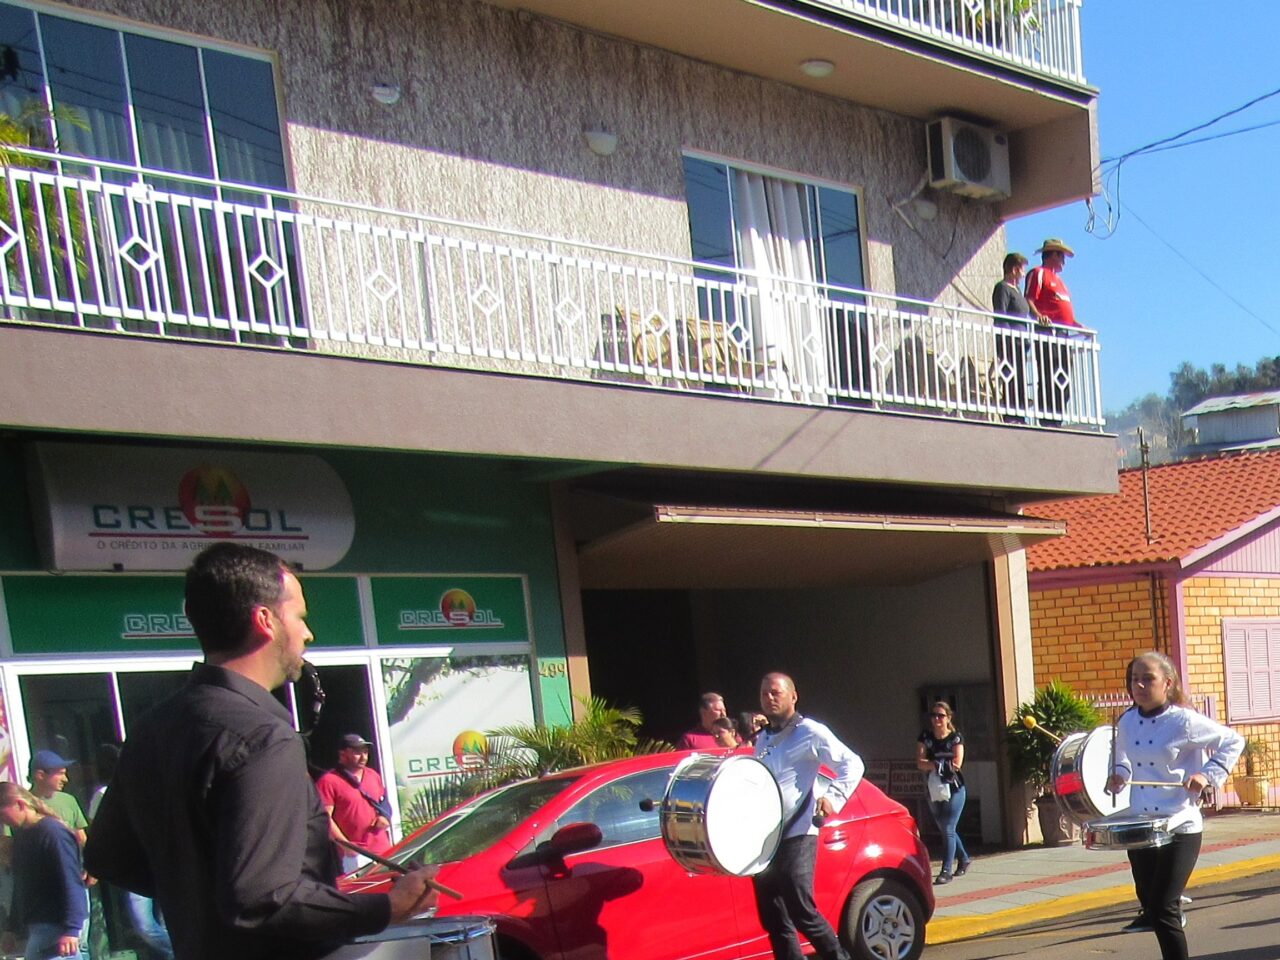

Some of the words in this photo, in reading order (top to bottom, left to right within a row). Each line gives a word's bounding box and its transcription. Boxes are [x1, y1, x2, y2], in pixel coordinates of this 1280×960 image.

[93, 504, 303, 533] CRESOL
[97, 541, 106, 550] O
[110, 539, 158, 550] CRÉDITO
[162, 541, 177, 550] DA
[258, 542, 305, 552] FAMILIAR
[400, 610, 502, 626] CRESOL
